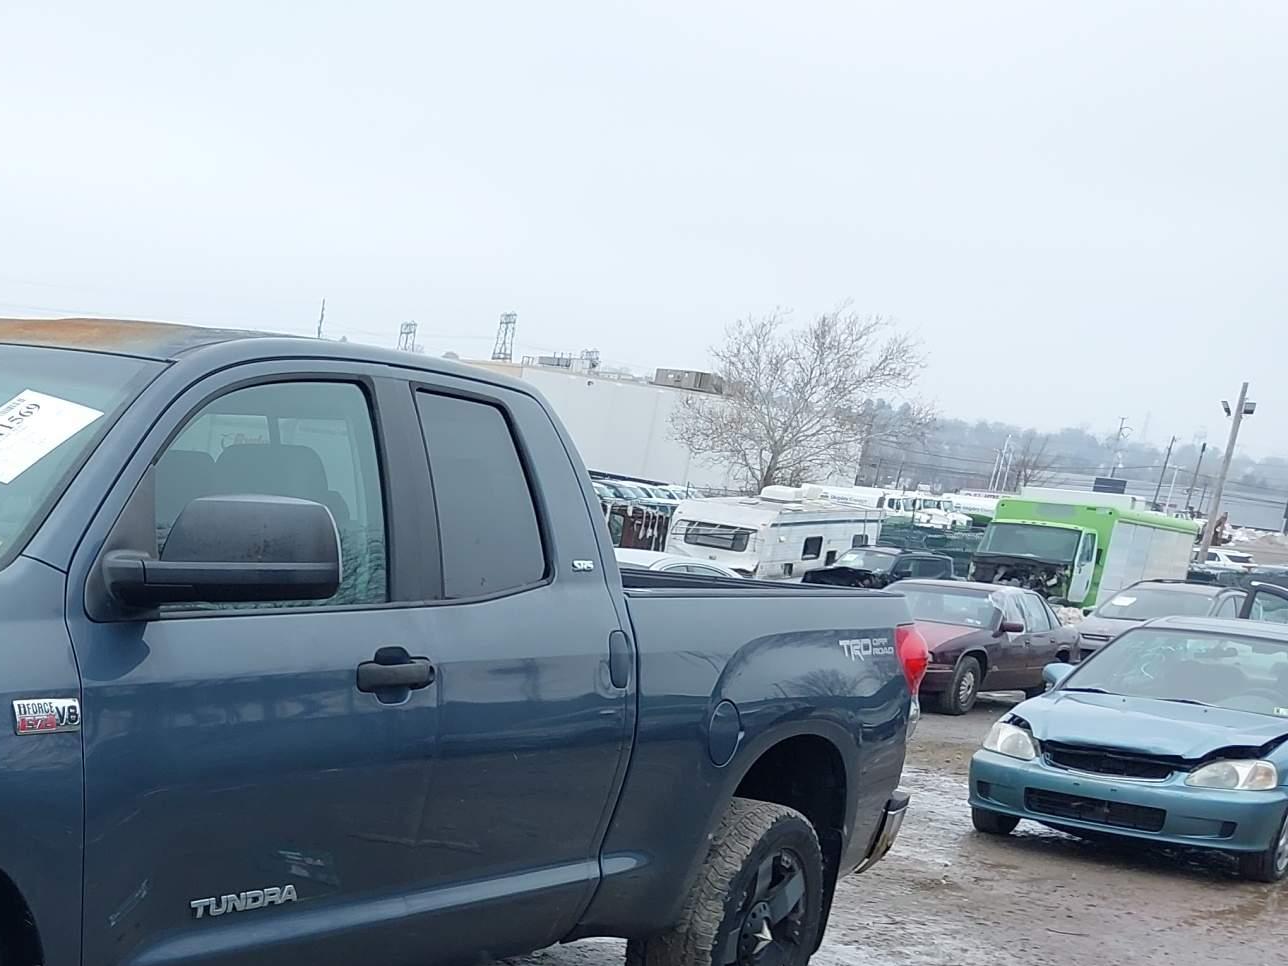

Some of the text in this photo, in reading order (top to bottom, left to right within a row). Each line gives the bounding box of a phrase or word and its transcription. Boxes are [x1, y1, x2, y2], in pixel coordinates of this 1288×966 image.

[839, 638, 872, 661] TRD
[55, 705, 79, 725] V8
[190, 884, 298, 919] TUNDRA
